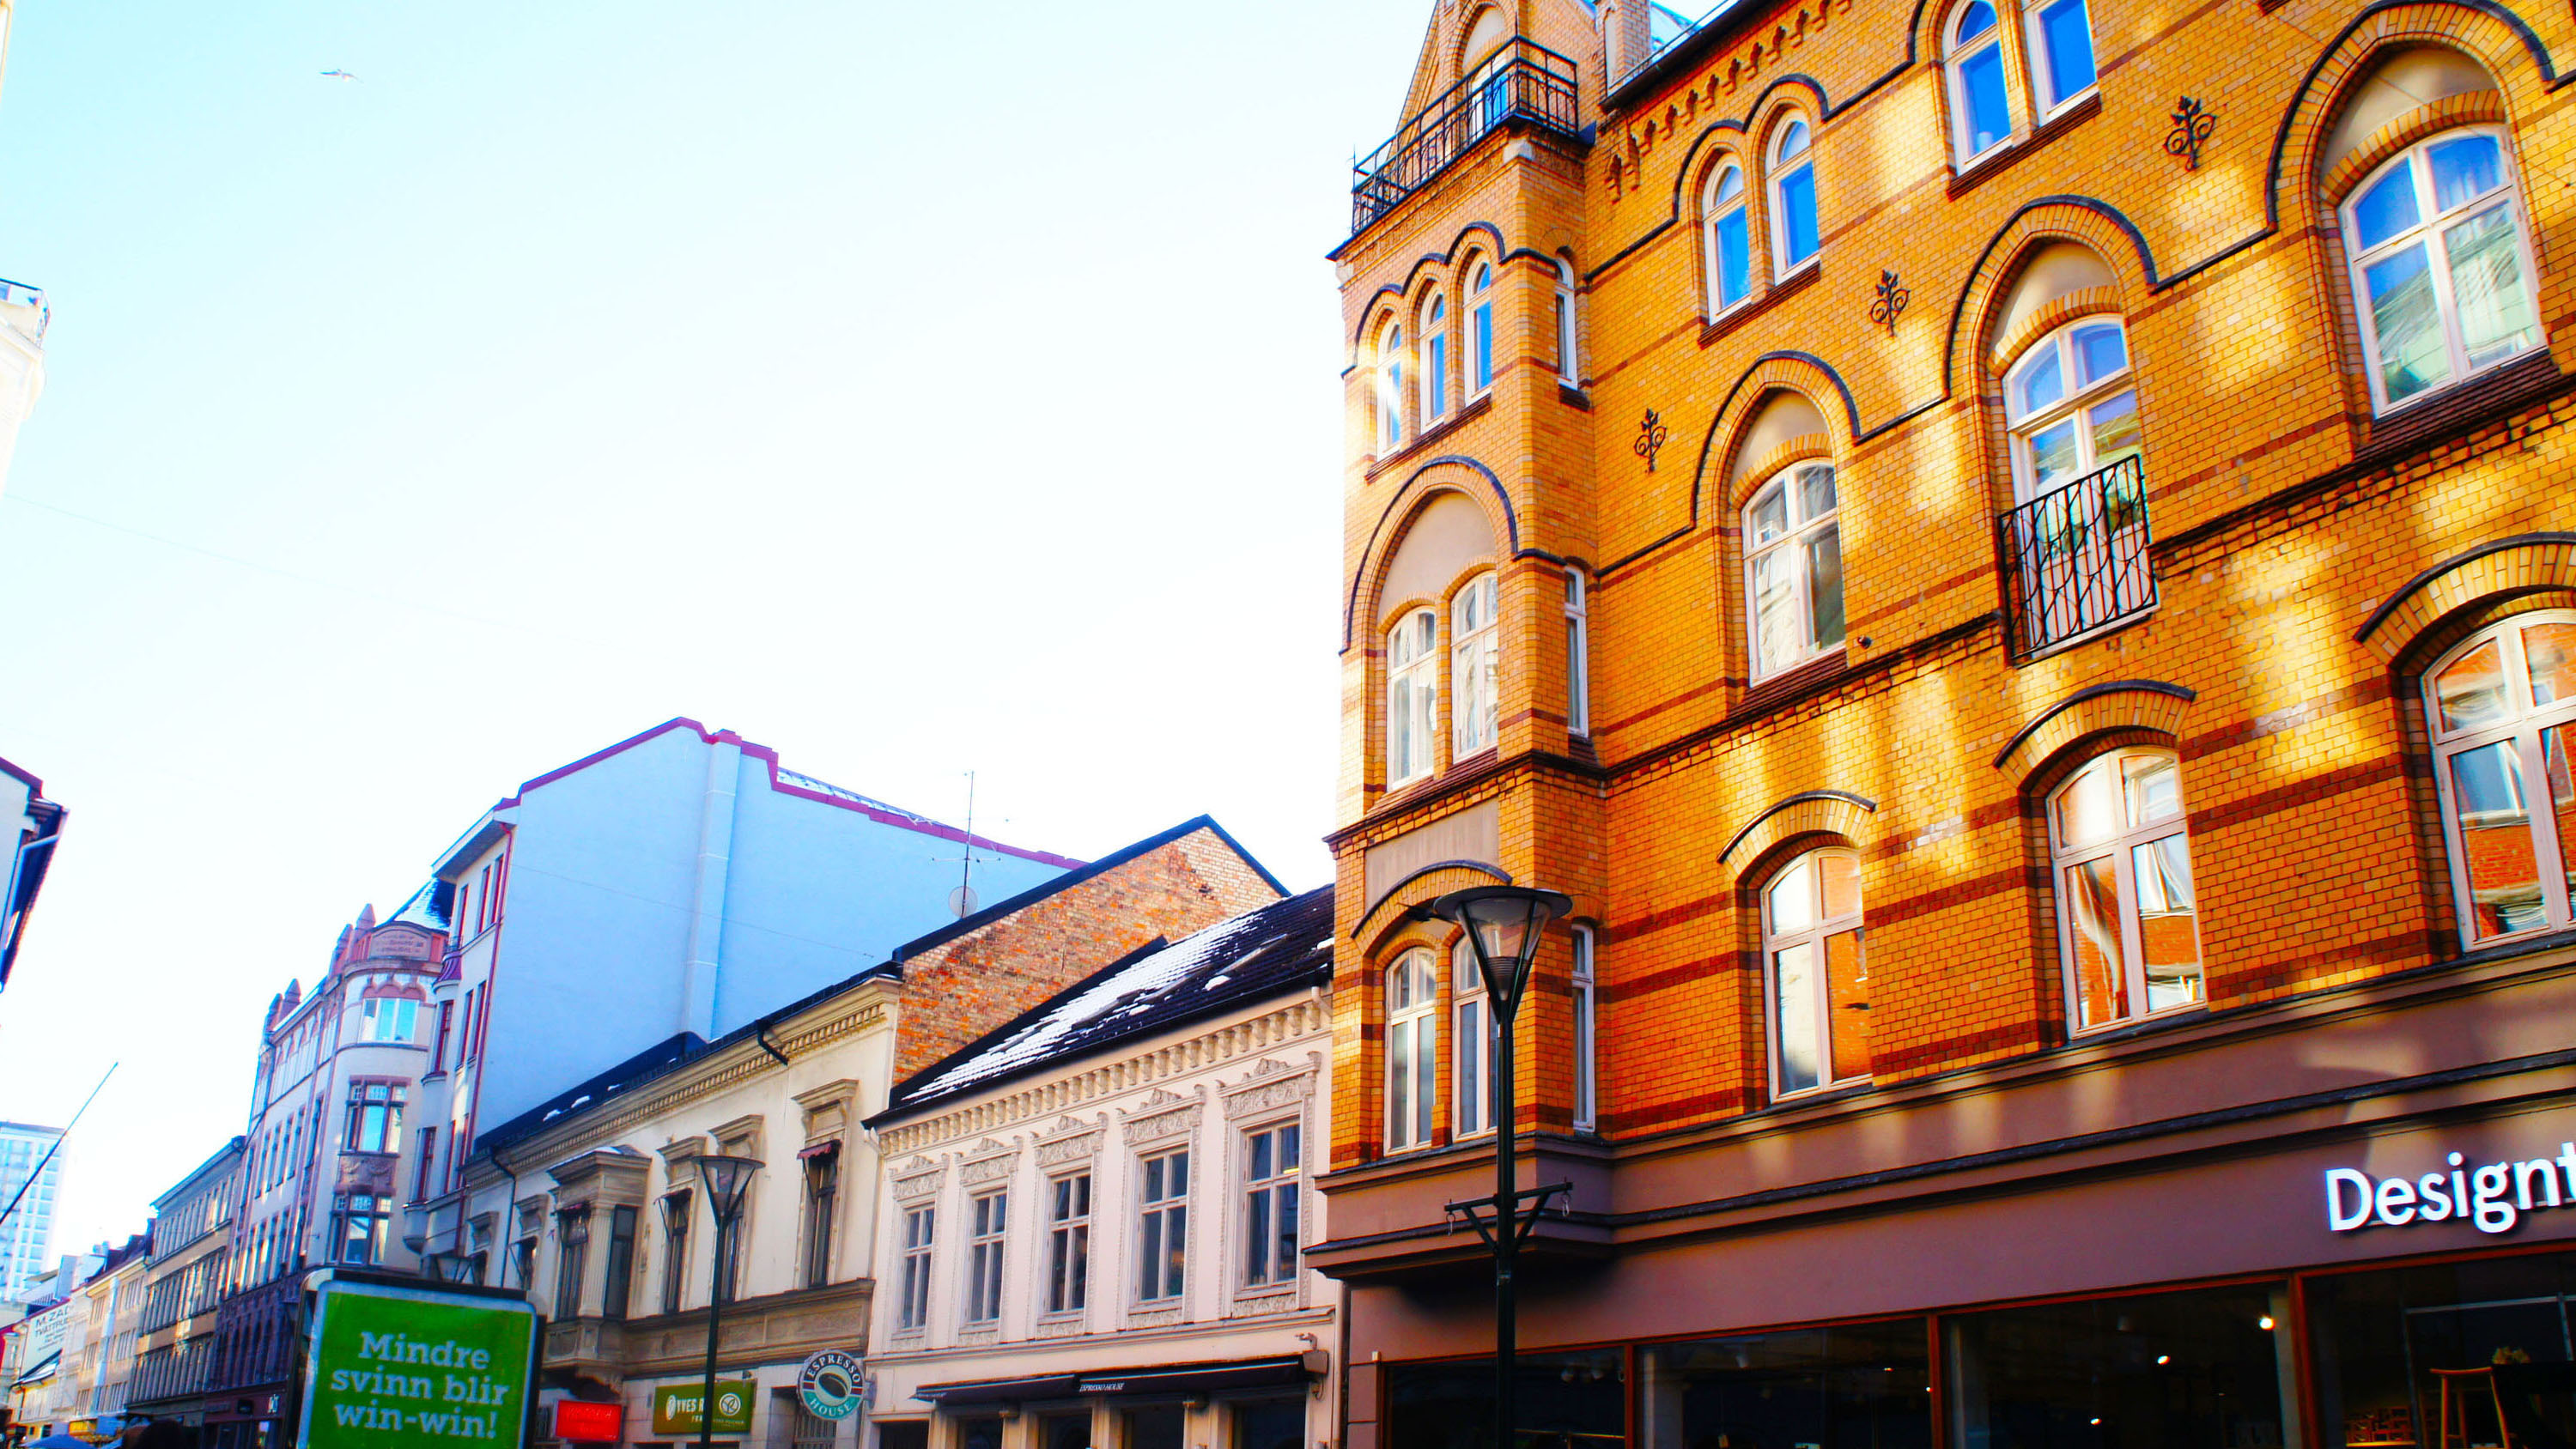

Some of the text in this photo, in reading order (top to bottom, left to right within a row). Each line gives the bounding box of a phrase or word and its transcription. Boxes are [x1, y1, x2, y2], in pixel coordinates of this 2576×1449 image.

[358, 1331, 490, 1370] Mindre
[331, 1365, 510, 1405] svinn blir
[807, 1354, 861, 1384] ESPRESSO
[334, 1398, 497, 1439] win-win!
[677, 1397, 697, 1413] YVES
[810, 1397, 853, 1416] HOUSE
